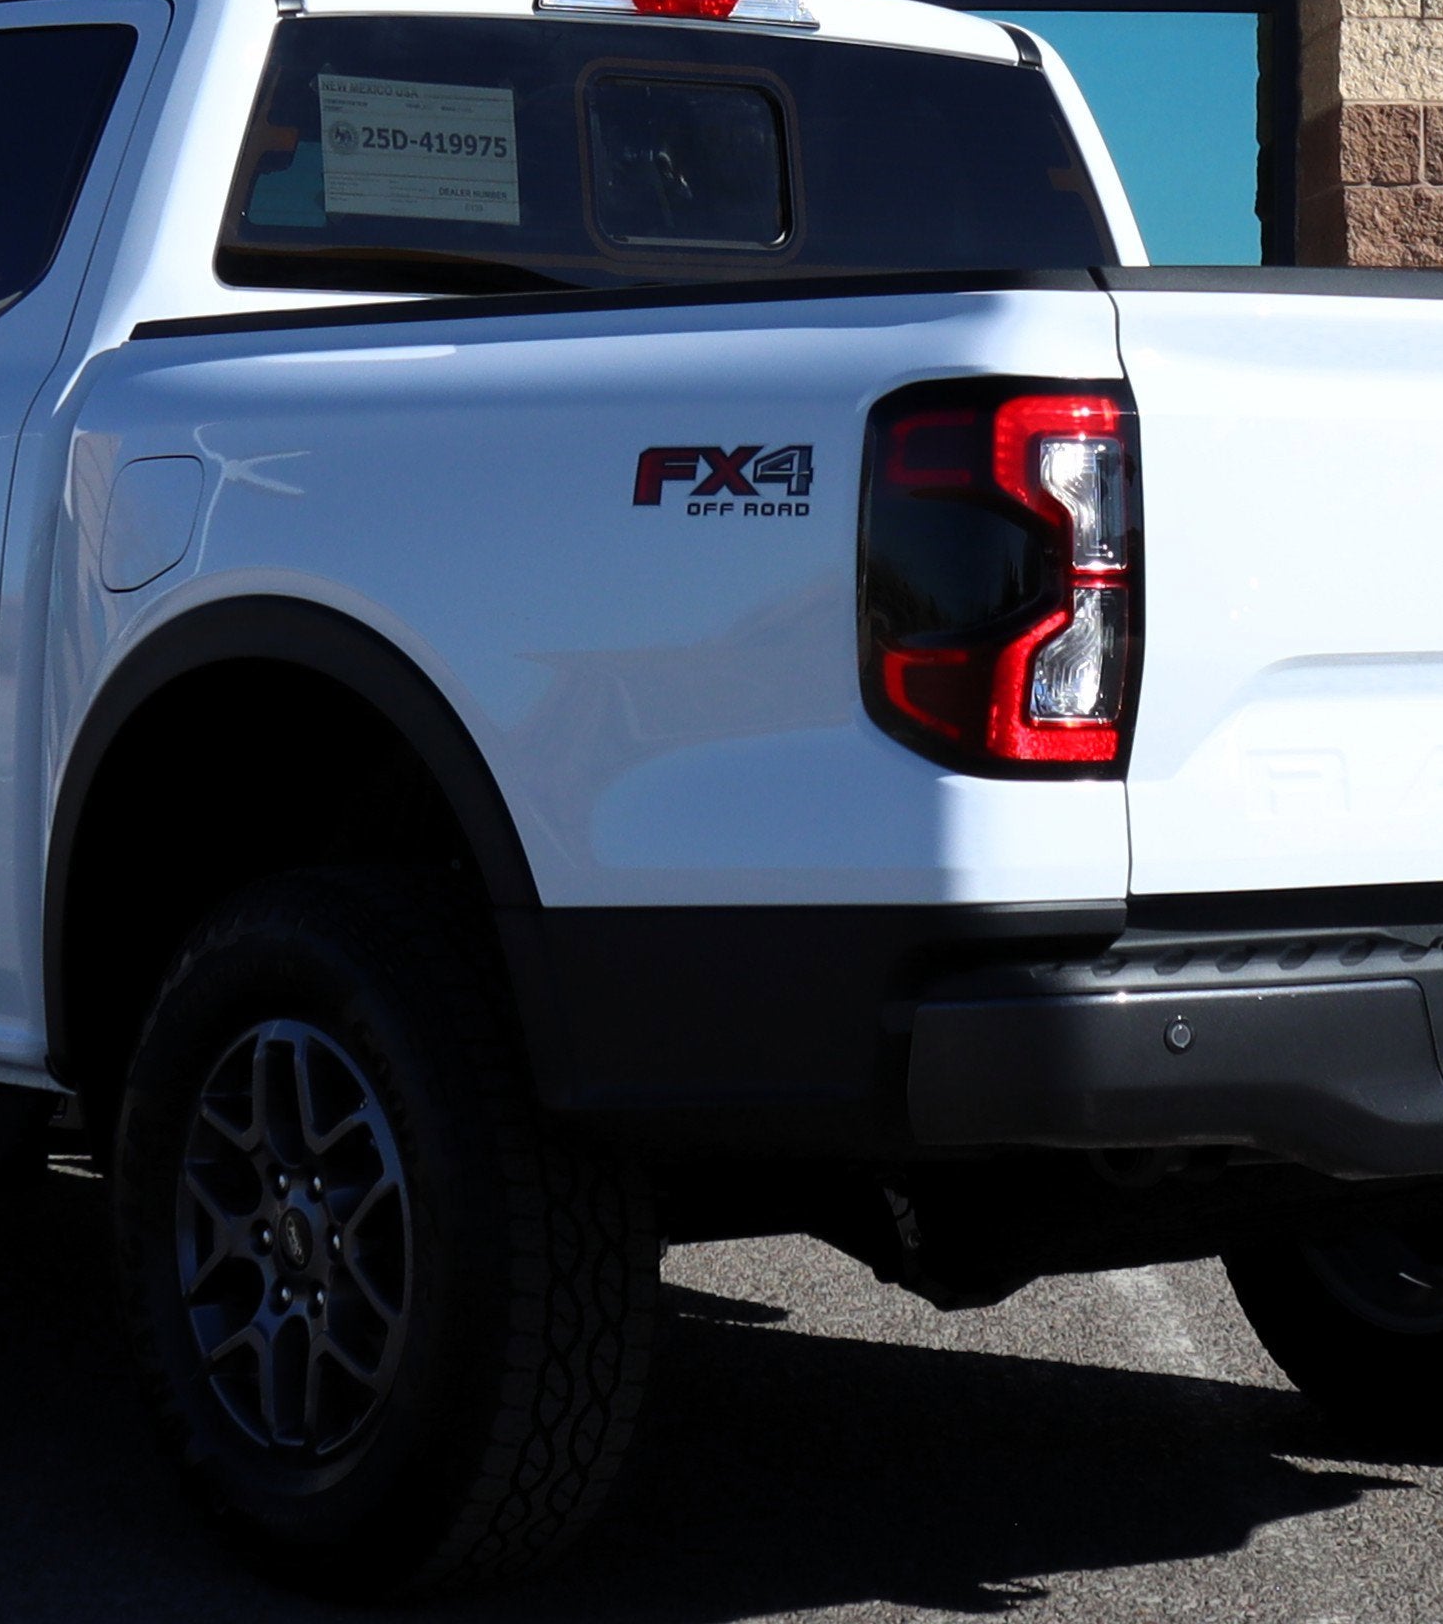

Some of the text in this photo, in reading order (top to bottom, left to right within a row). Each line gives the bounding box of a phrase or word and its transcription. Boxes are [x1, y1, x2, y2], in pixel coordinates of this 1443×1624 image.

[322, 81, 347, 92] NEW
[350, 83, 393, 96] MEXICO
[362, 127, 507, 158] 25D-419975
[438, 187, 507, 200] DEALER NUMBER
[632, 445, 813, 506] FX4
[687, 503, 810, 516] OFF ROAD
